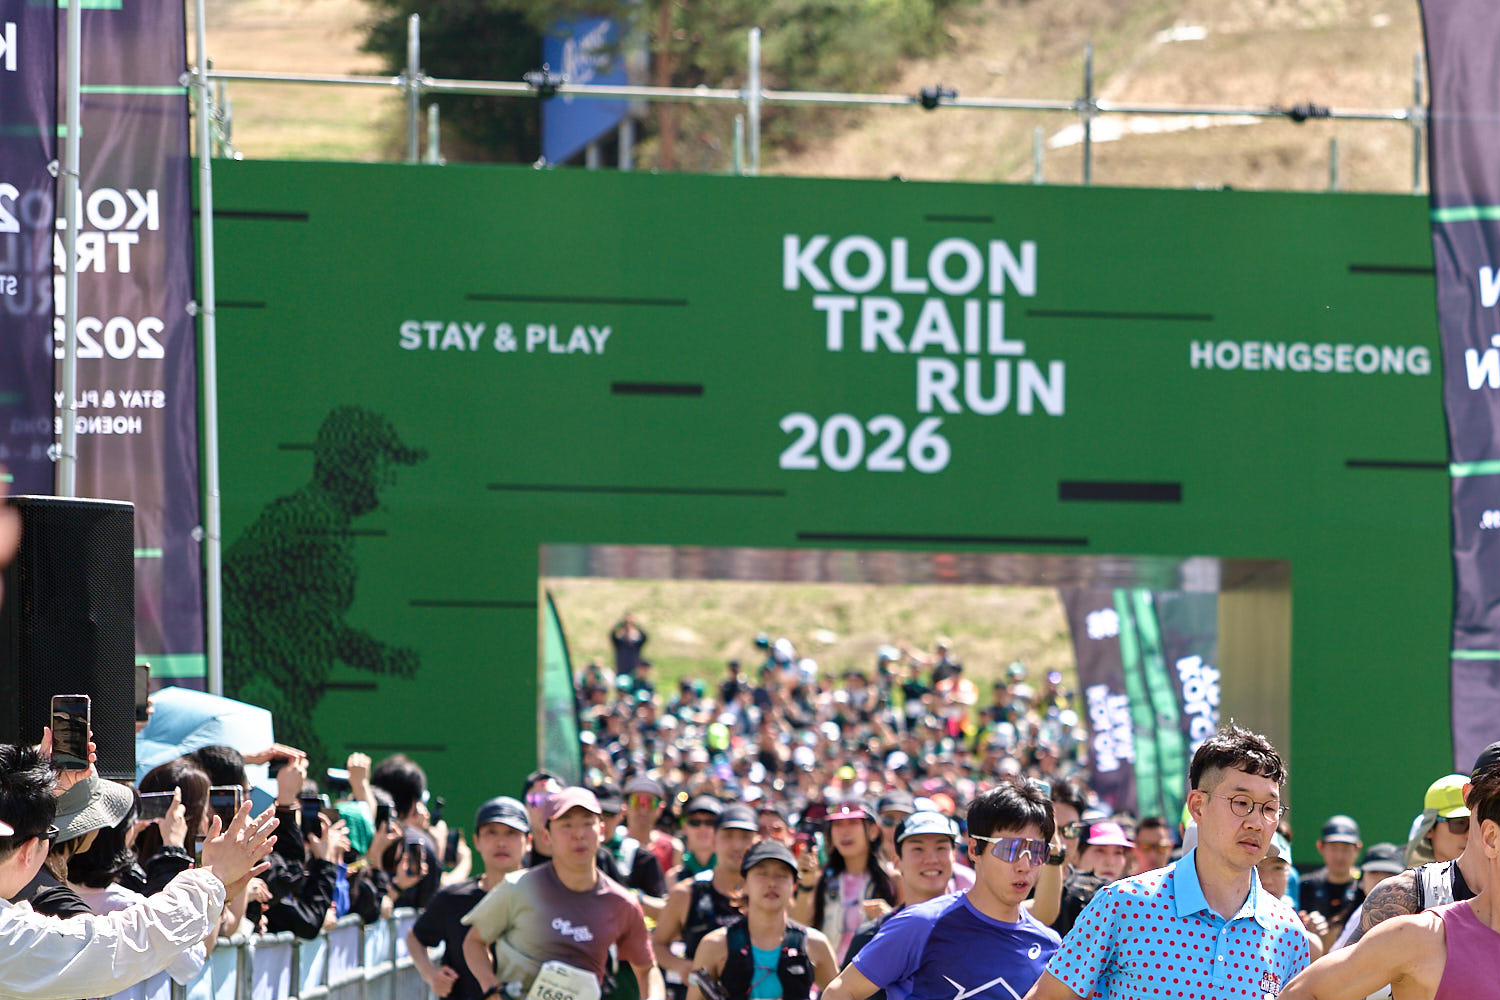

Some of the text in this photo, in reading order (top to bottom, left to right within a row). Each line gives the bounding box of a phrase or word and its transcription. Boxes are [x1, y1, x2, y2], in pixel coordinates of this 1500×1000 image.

[782, 233, 1038, 297] KOLON
[398, 320, 612, 354] STAY & PLAY
[813, 295, 1025, 355] TRAIL
[916, 357, 1066, 416] RUN
[1189, 340, 1432, 375] HOENGSEONG
[779, 412, 951, 473] 2026
